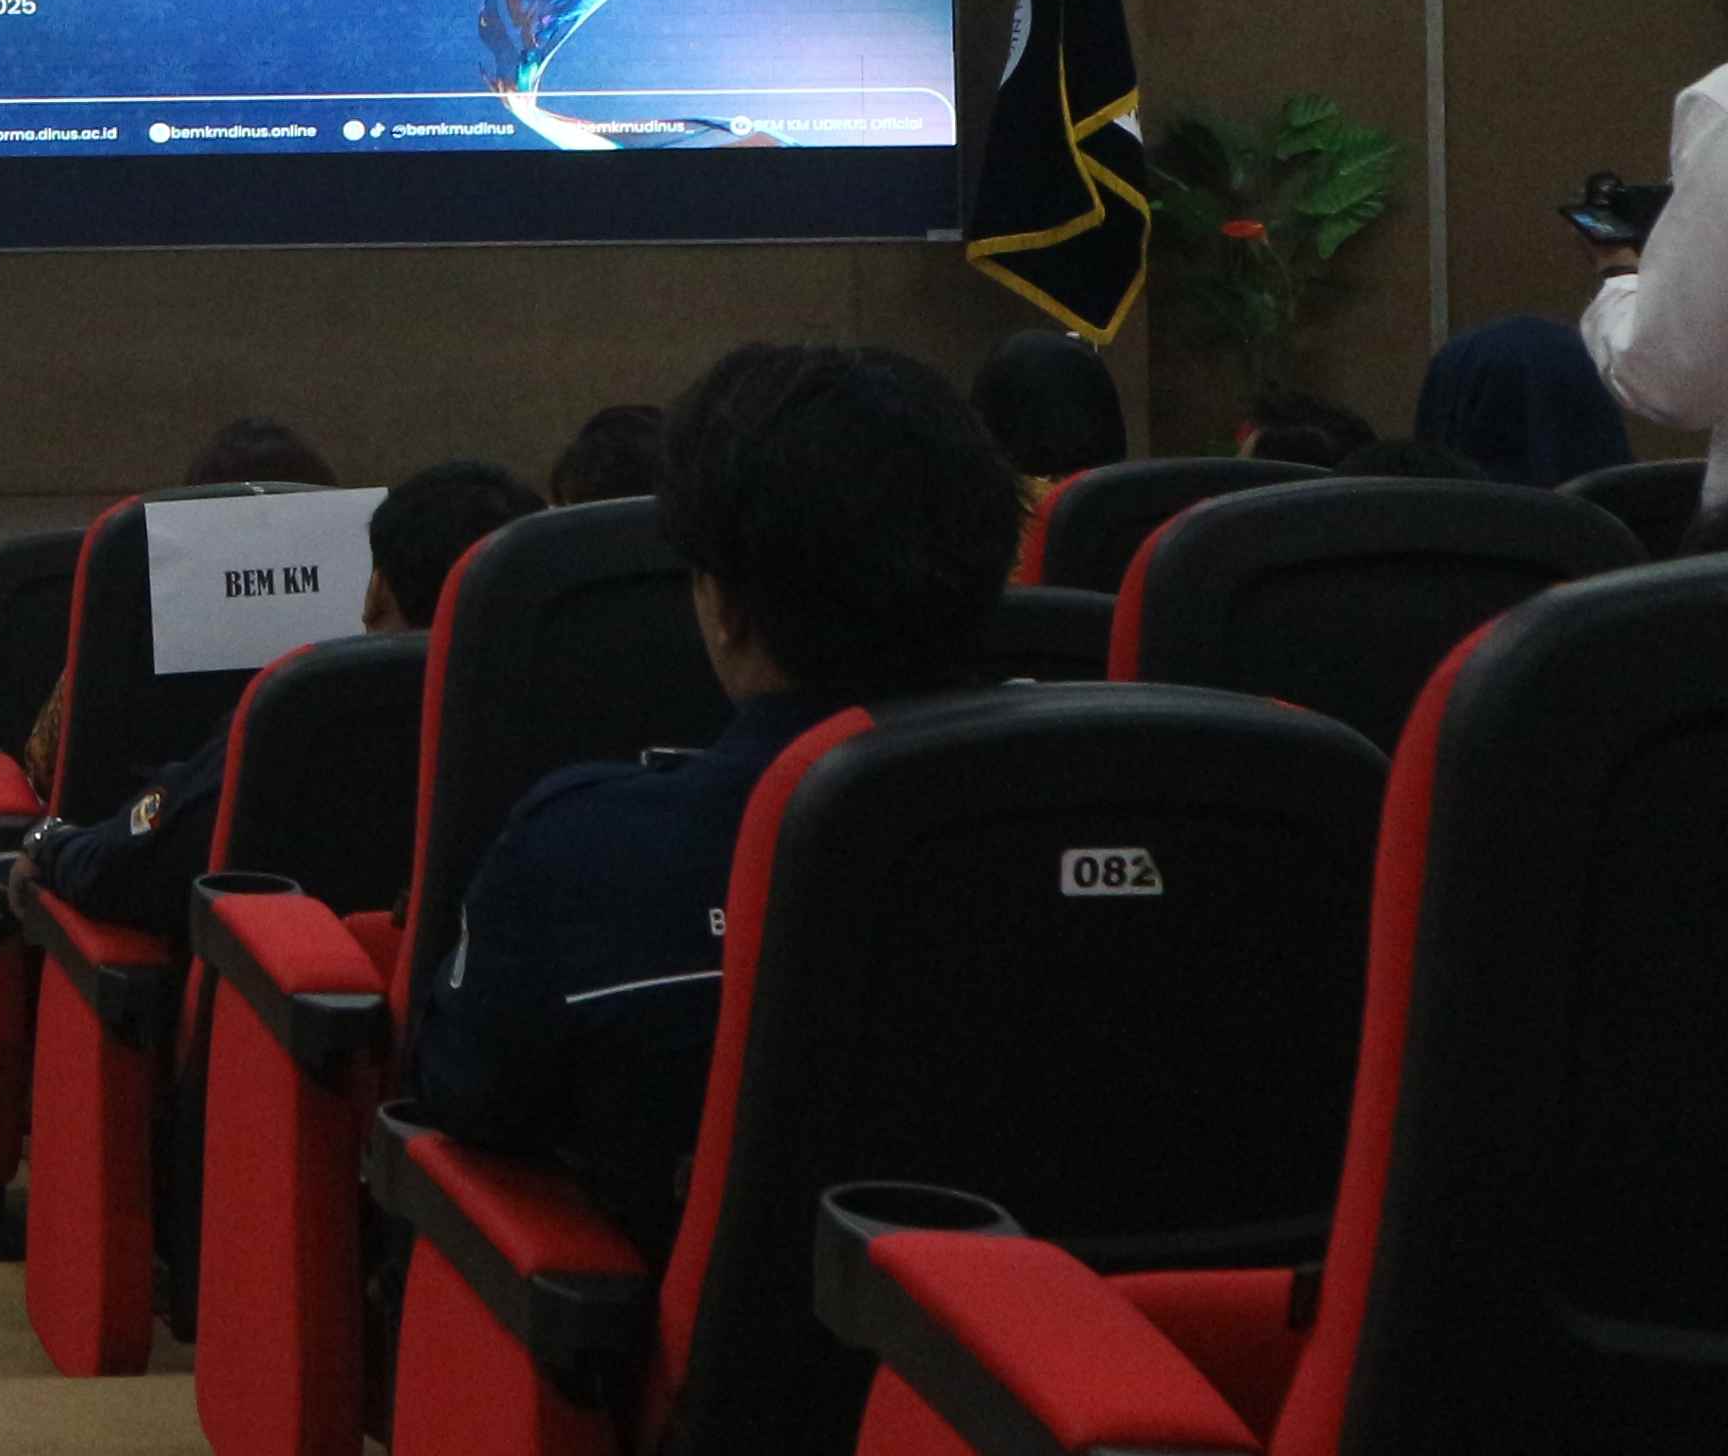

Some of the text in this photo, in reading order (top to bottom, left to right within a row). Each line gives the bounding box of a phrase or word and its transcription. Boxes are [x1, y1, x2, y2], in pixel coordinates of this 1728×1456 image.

[170, 124, 318, 140] bemkmdinus.online
[224, 565, 320, 598] BEM KM
[1074, 856, 1156, 887] 082
